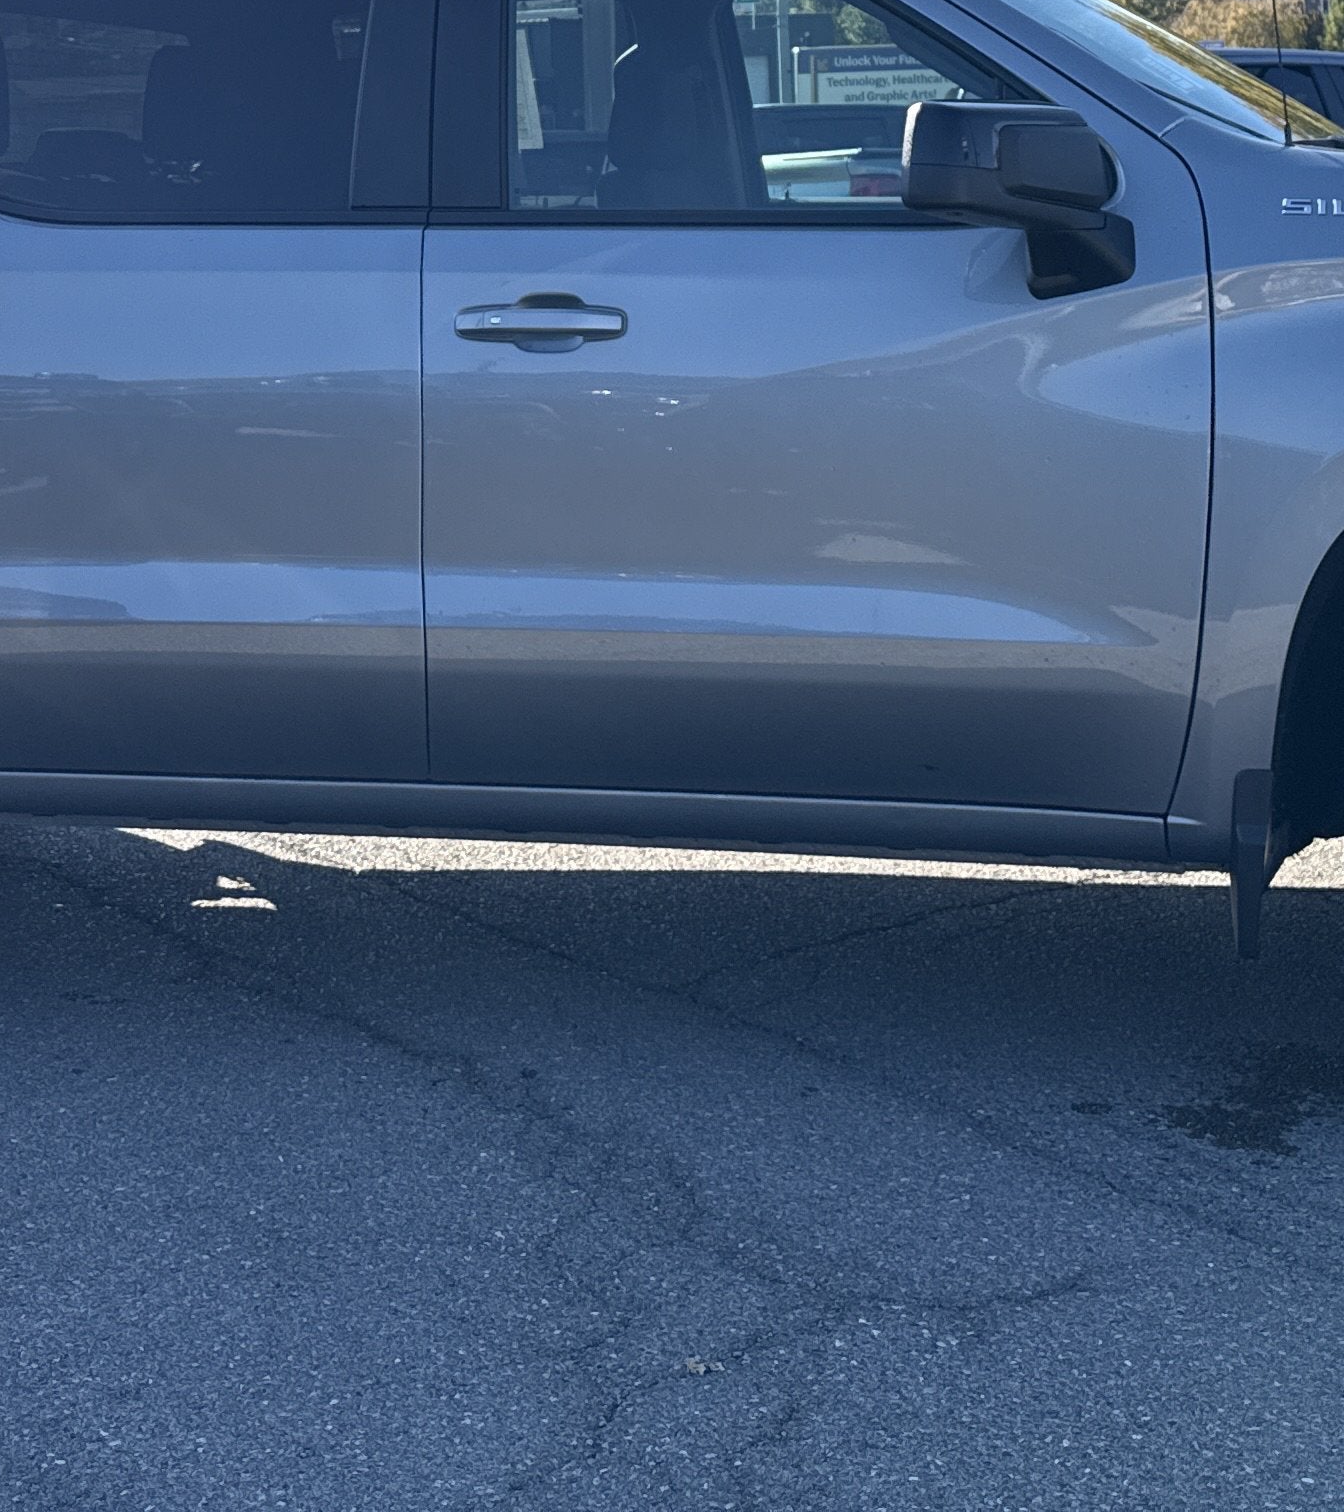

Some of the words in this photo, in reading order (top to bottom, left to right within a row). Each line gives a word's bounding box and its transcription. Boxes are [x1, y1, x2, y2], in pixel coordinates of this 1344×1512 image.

[834, 55, 871, 67] Unlock
[872, 55, 897, 66] Your
[899, 53, 921, 65] Fut
[827, 76, 891, 88] Technology,
[845, 92, 864, 102] and
[866, 90, 909, 104] Graphic
[911, 88, 937, 99] Arts!
